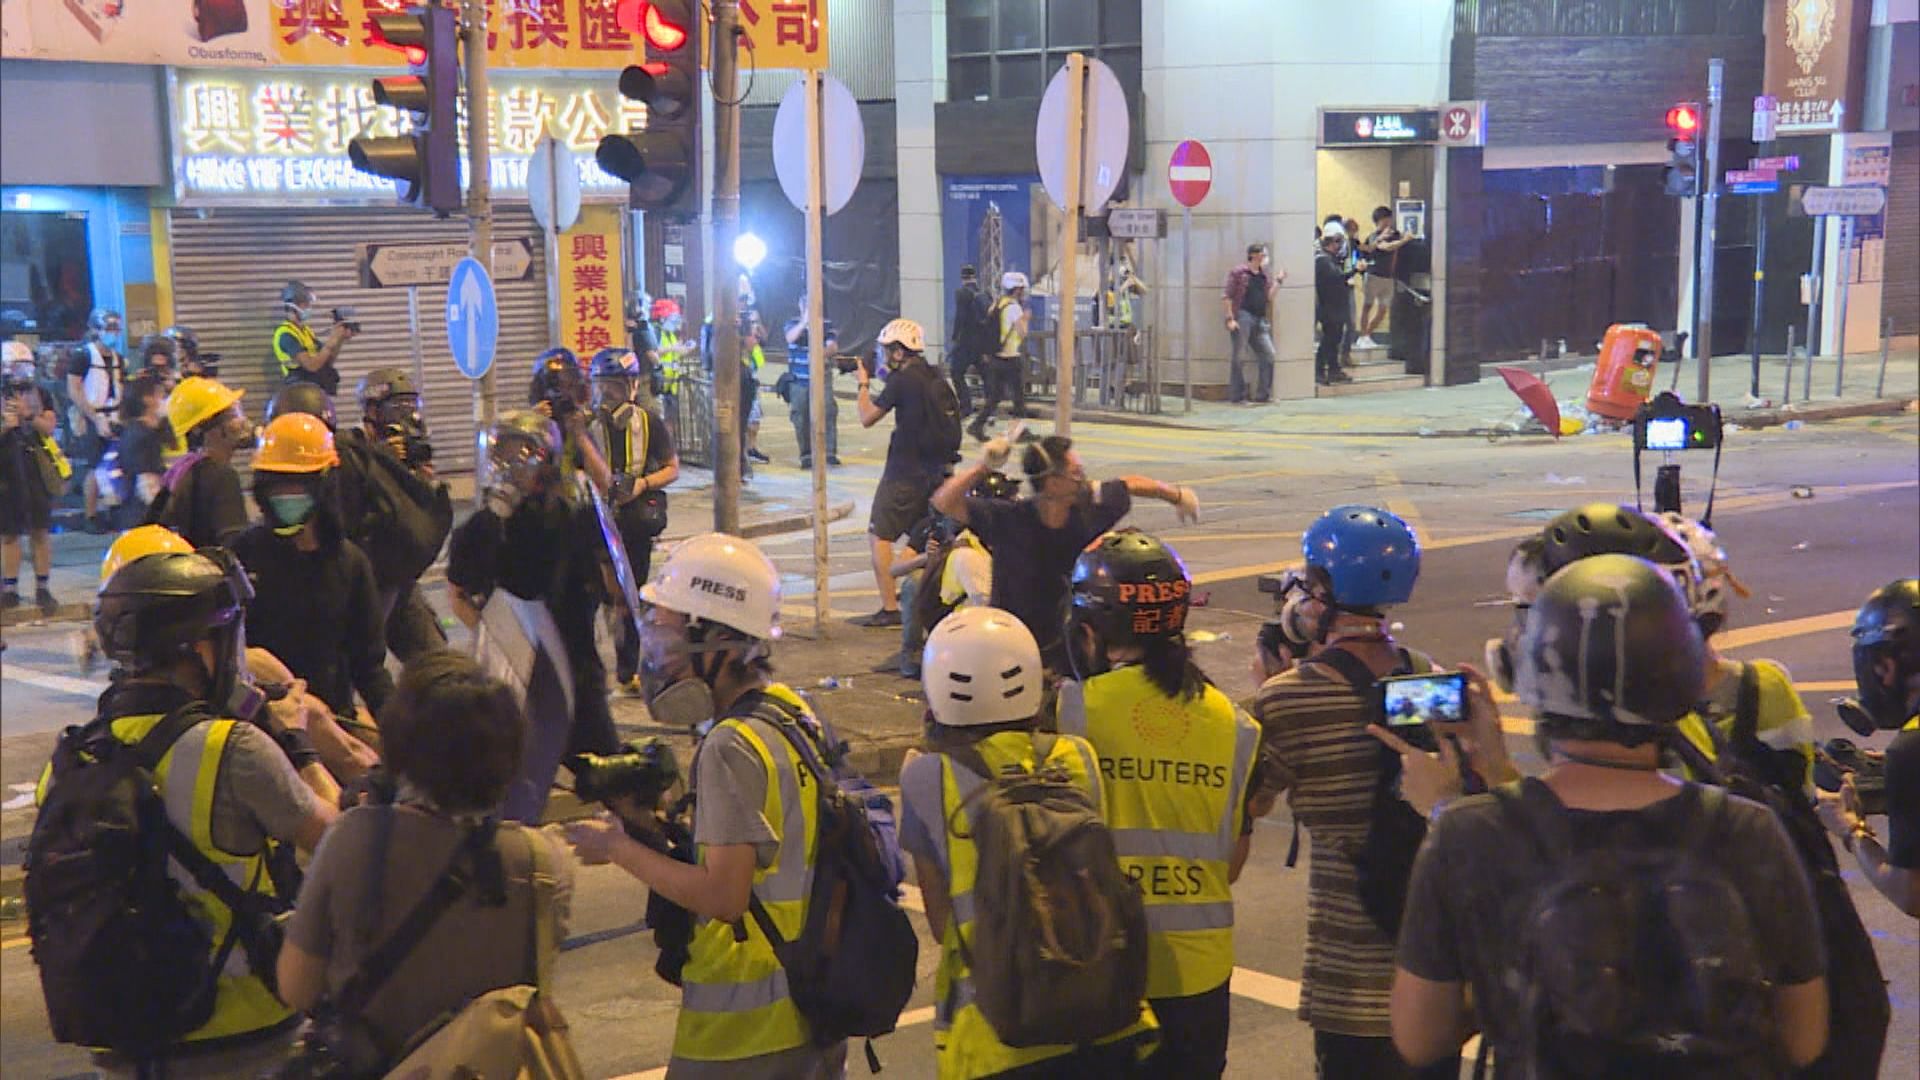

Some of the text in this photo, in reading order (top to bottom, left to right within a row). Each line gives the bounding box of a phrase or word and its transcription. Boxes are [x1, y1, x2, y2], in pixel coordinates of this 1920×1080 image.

[571, 235, 611, 372] 興業找換
[690, 576, 747, 601] PRESS
[1119, 580, 1189, 603] PRES
[1099, 757, 1228, 788] REUTERS
[1126, 864, 1205, 896] RESS
